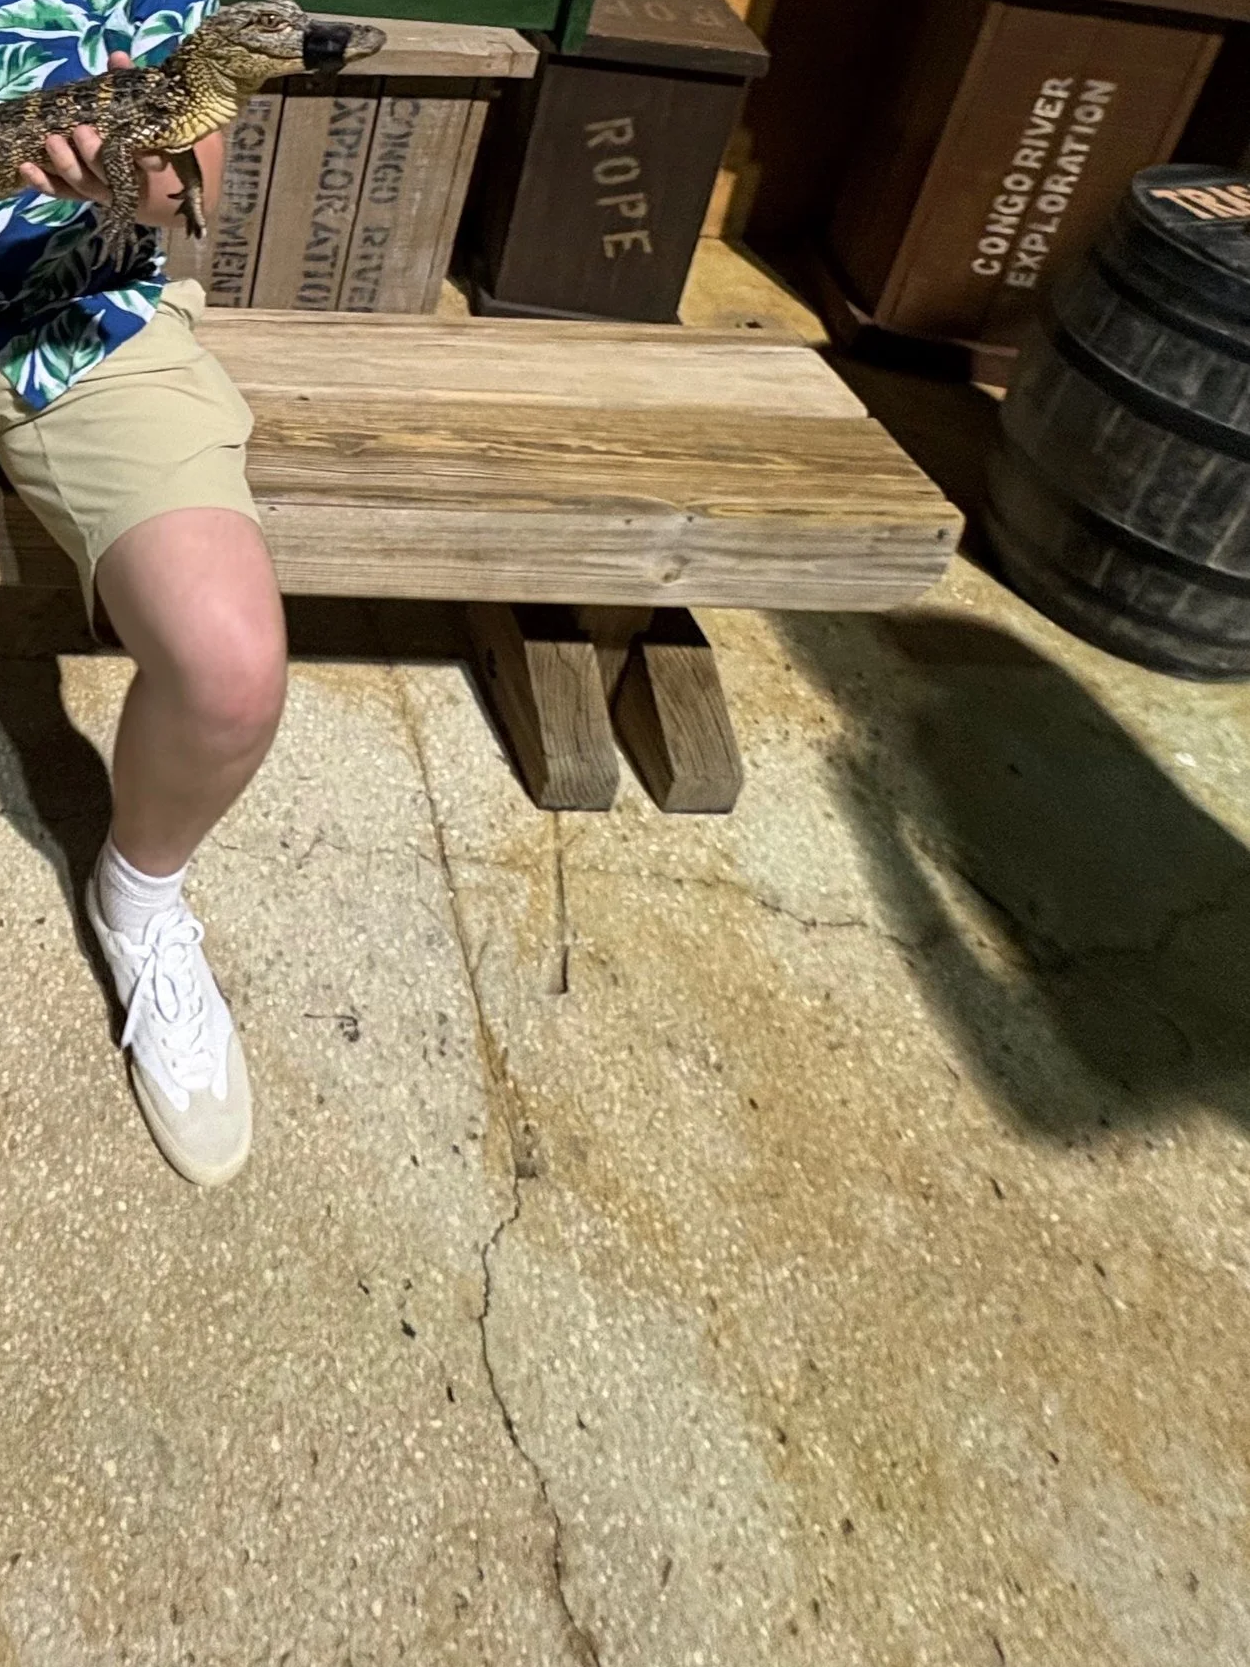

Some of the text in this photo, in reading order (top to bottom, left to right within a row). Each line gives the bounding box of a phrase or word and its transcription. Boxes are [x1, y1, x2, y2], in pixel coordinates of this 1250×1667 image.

[291, 98, 369, 312] XPLORATIO
[368, 97, 422, 205] CONGO
[584, 116, 651, 260] ROPE
[971, 77, 1075, 275] CONGO RIVER
[1005, 79, 1118, 289] EXPLORATION
